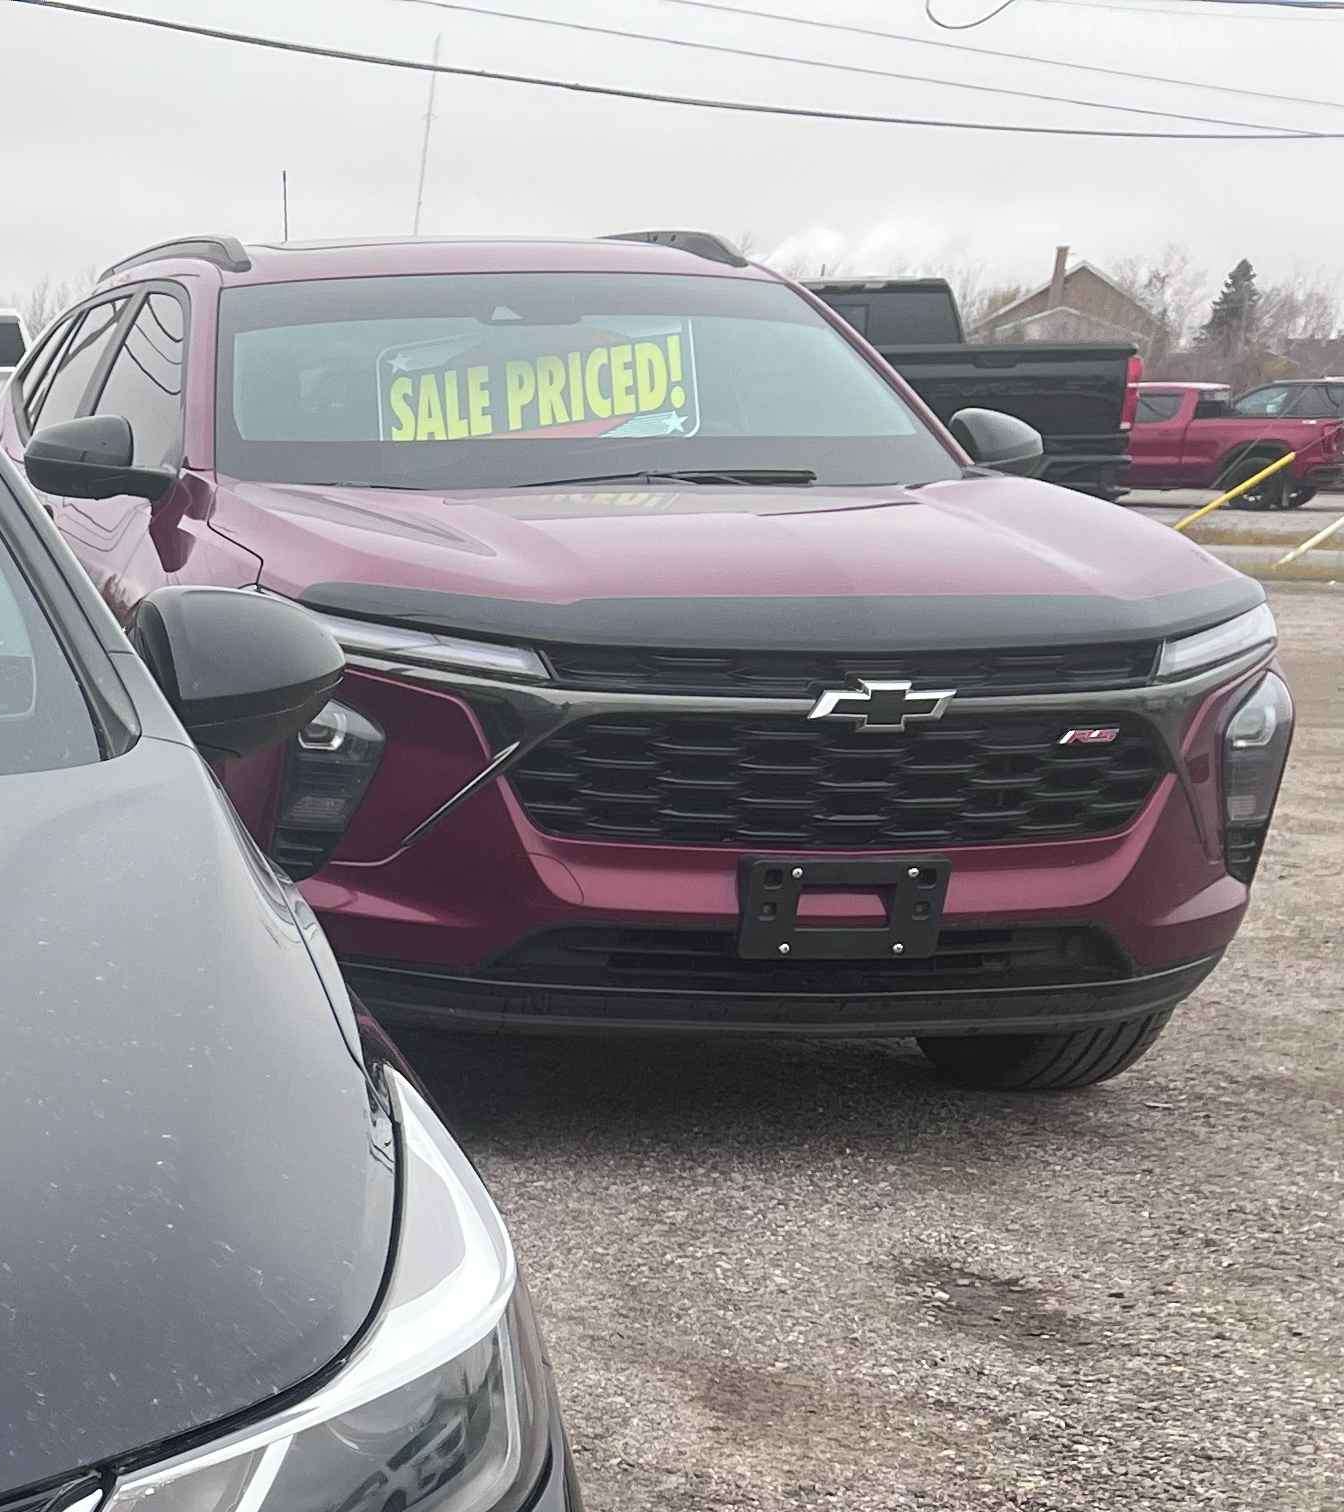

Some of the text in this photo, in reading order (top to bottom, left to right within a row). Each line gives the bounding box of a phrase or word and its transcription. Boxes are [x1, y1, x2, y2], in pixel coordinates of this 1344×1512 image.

[390, 335, 686, 441] SALE PRICED!
[1059, 728, 1120, 744] RS
